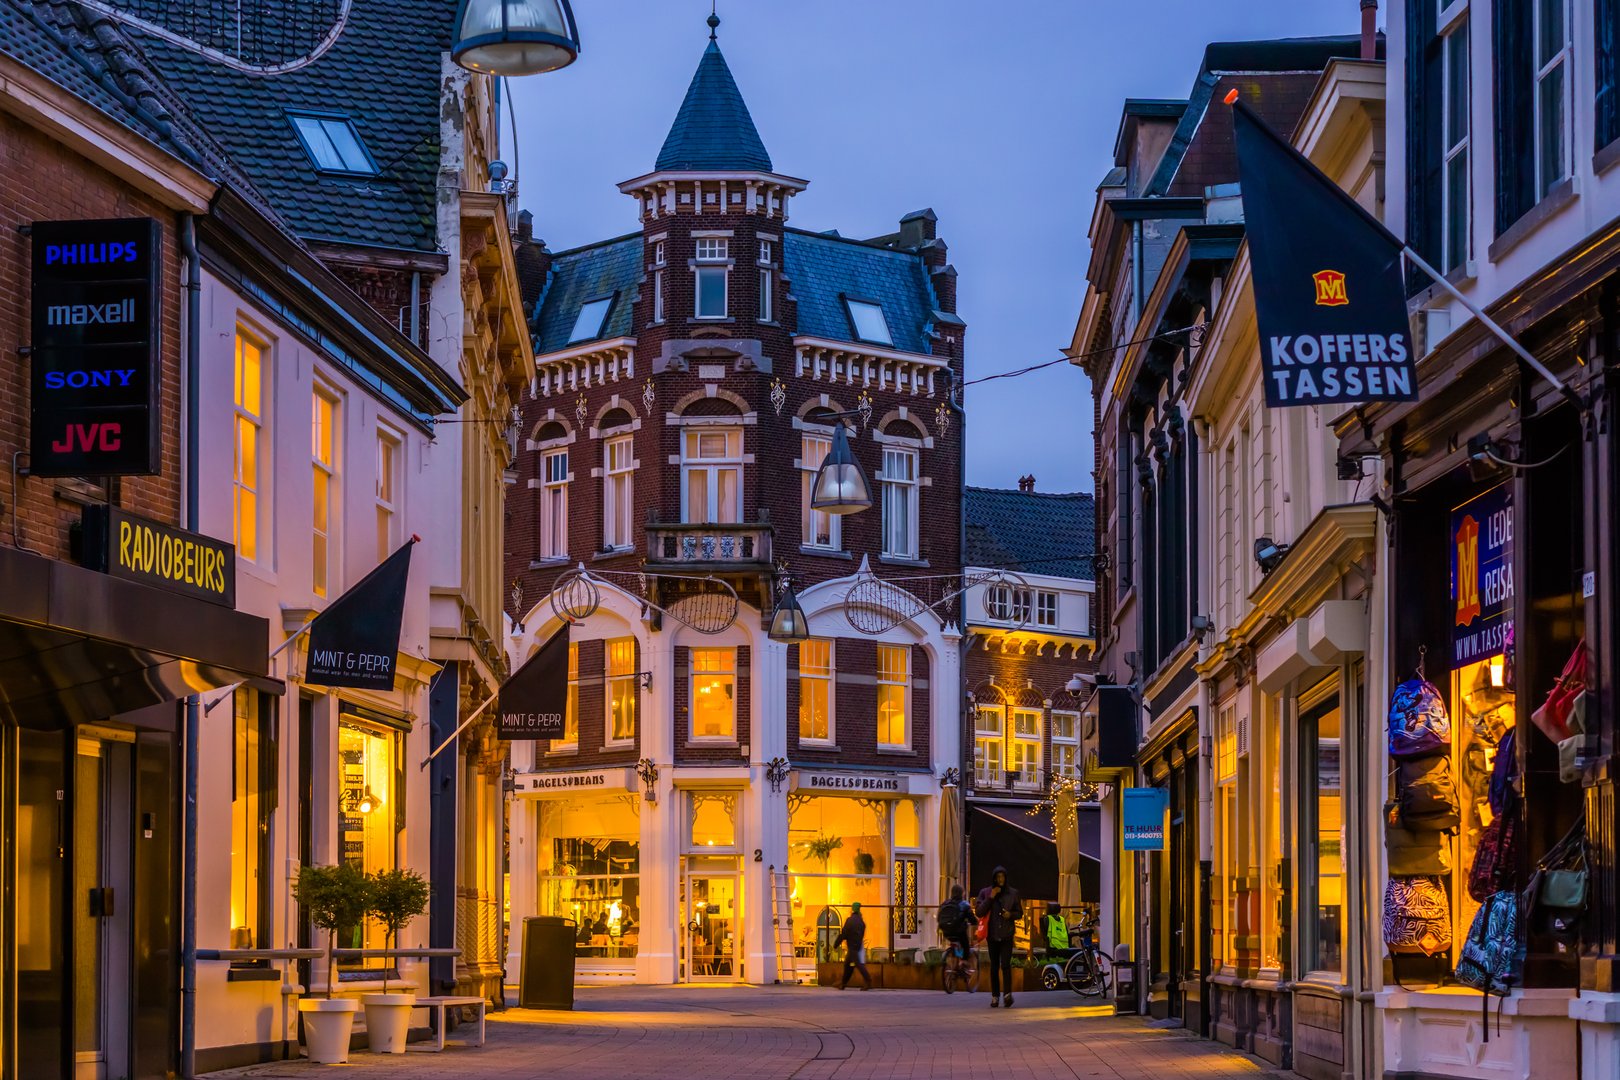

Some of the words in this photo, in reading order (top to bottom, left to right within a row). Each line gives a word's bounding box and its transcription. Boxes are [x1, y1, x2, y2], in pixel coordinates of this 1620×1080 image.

[46, 241, 137, 265] PHILIPS
[47, 298, 135, 325] maxell
[1269, 333, 1407, 366] KOFFERS
[45, 369, 136, 389] SONY
[1272, 366, 1412, 400] TASSEN
[52, 422, 121, 453] JVC
[119, 521, 225, 593] RADIOBEURS
[313, 649, 344, 668] MINT
[346, 652, 356, 669] &
[358, 653, 390, 673] PEPR
[502, 713, 526, 726] MINT
[528, 713, 536, 727] &
[537, 713, 562, 726] PEPR
[532, 776, 567, 789] BAGELS
[574, 774, 605, 786] BEANS
[811, 776, 854, 788] BAGELS
[862, 778, 898, 790] BEANS
[1125, 825, 1135, 833] TE
[1136, 825, 1162, 833] HUUR
[754, 848, 763, 863] 2
